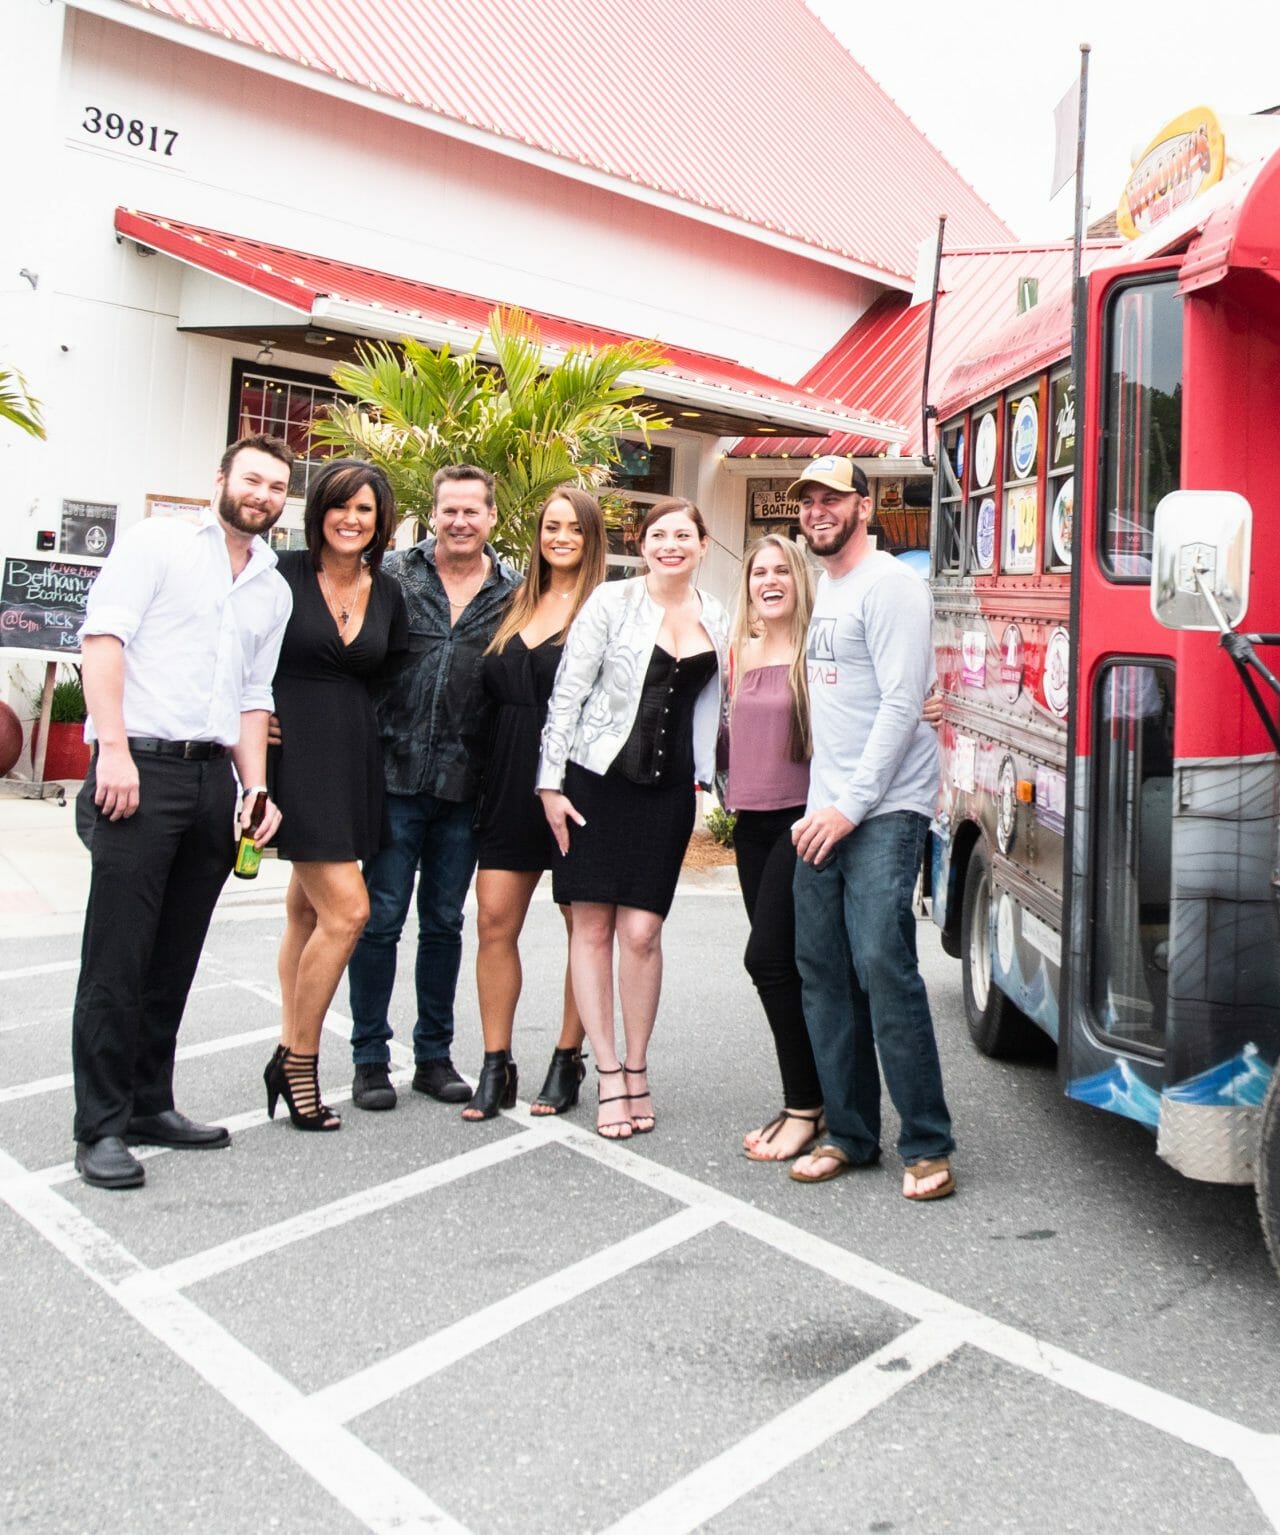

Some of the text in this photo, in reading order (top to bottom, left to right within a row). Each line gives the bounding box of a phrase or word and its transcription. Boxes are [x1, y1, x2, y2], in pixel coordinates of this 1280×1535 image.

[82, 106, 179, 156] 39817
[761, 503, 800, 517] BOATHO
[44, 611, 74, 627] RICK
[807, 666, 837, 684] RVC
